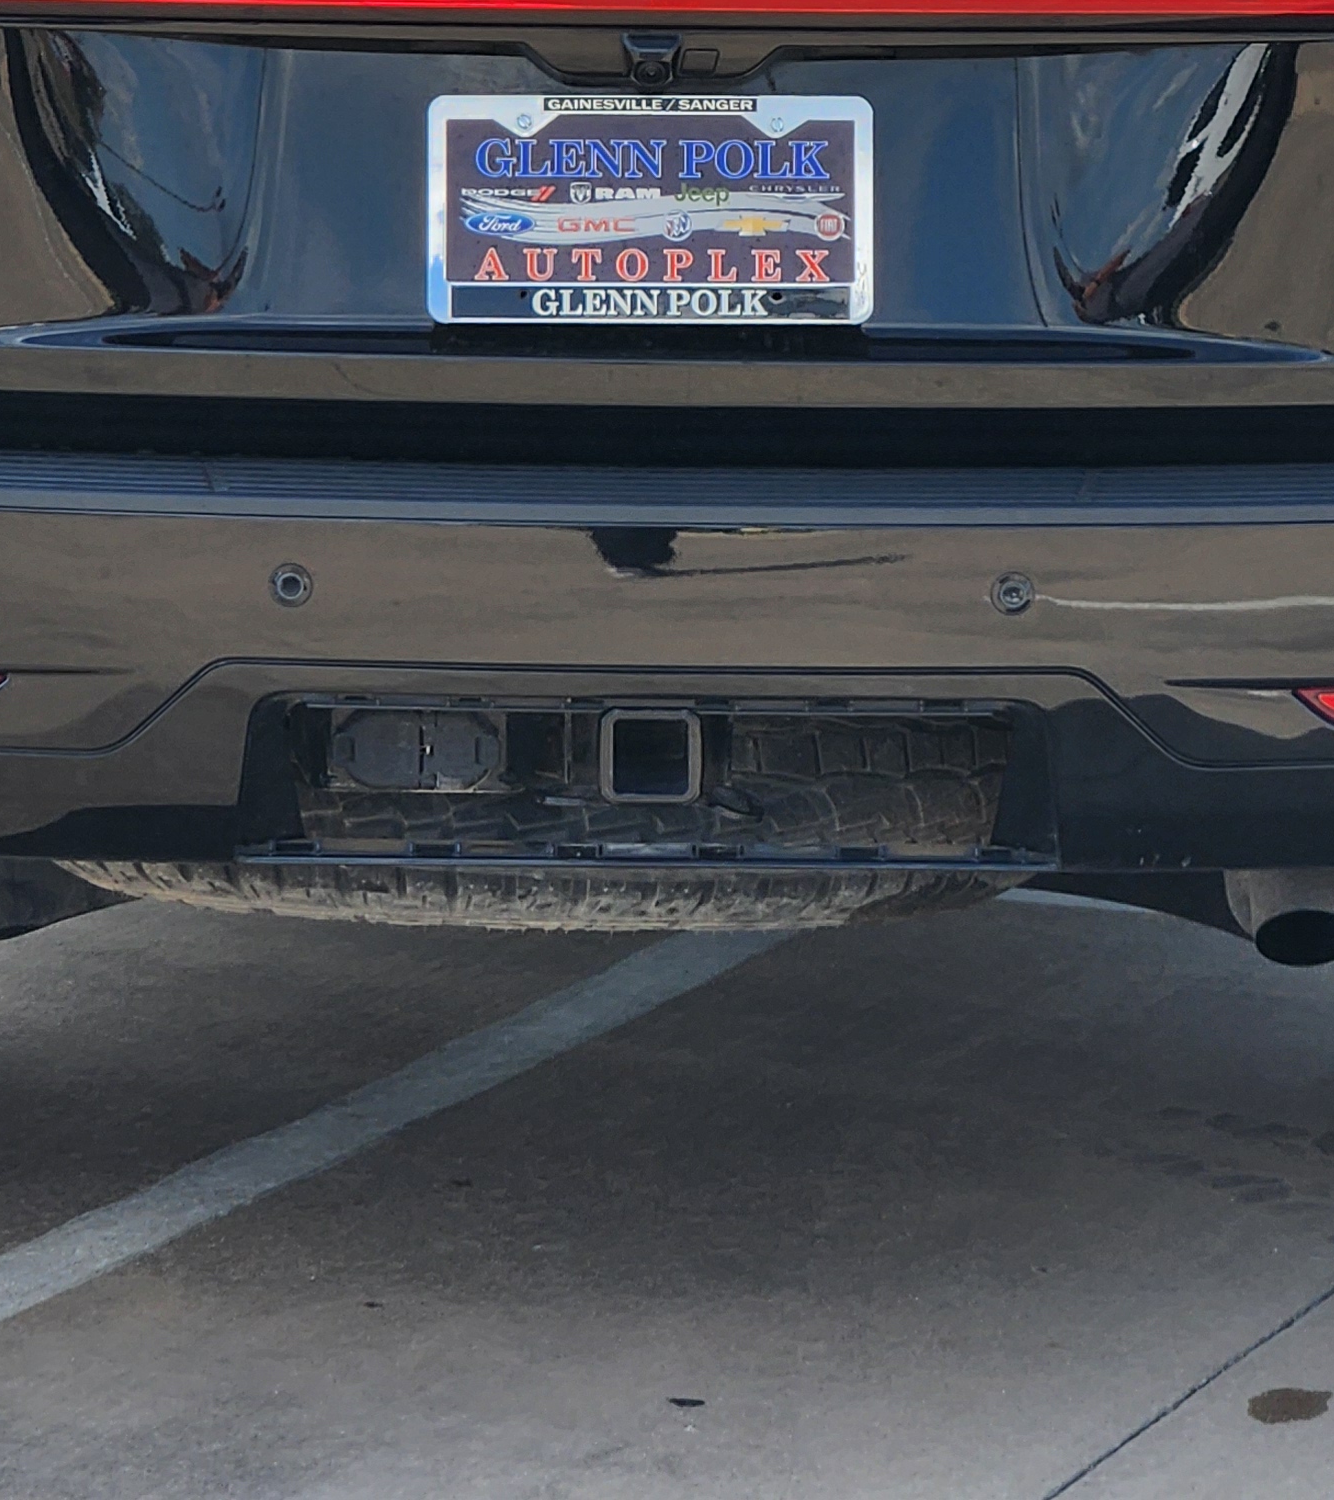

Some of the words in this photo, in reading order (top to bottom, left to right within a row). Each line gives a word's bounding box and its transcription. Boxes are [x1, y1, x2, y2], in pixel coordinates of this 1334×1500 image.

[475, 137, 665, 178] GLENN
[678, 139, 830, 179] POLK
[461, 188, 540, 197] DODGE
[595, 187, 662, 200] RAM
[674, 183, 730, 206] Jeep
[748, 184, 841, 193] CHRYSLER
[478, 214, 522, 232] Ford
[557, 216, 636, 232] GMC
[820, 219, 838, 231] FIAT
[474, 248, 830, 282] AUTOPLEX
[532, 288, 661, 316] GLENN
[667, 288, 769, 315] POLK
